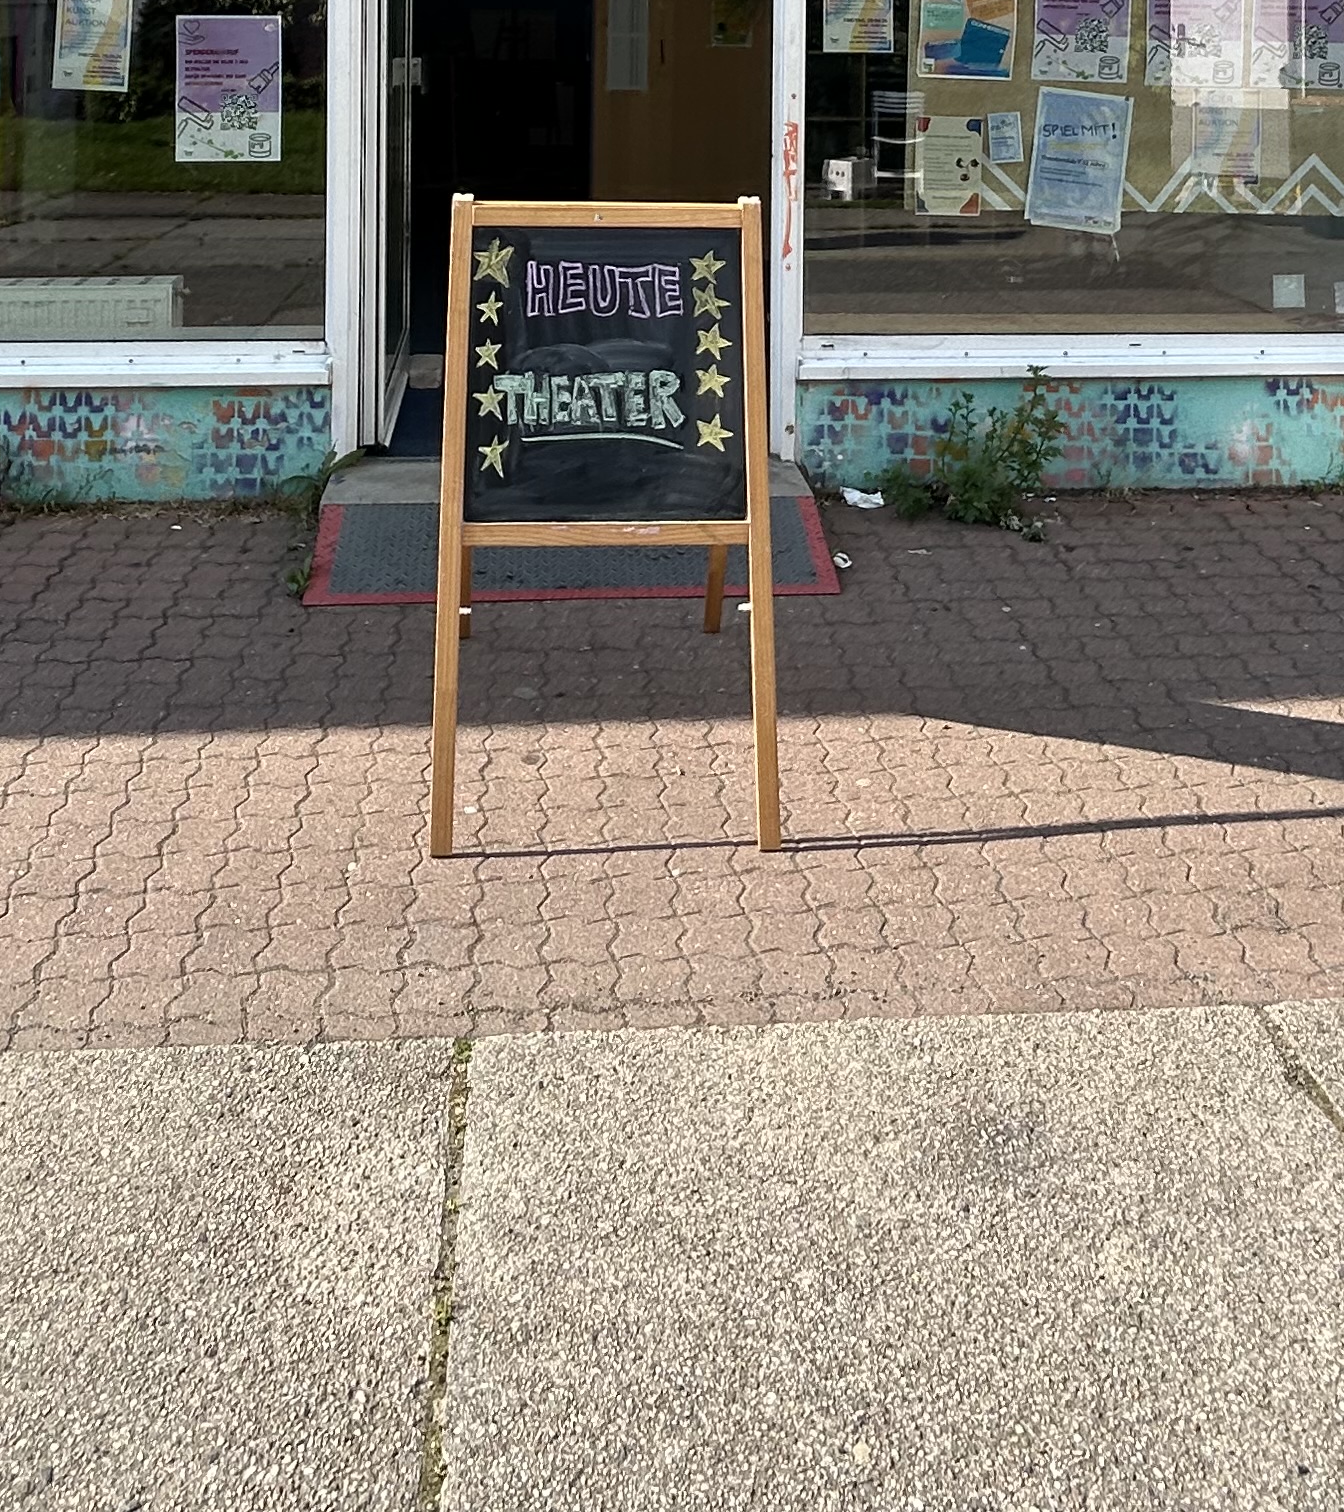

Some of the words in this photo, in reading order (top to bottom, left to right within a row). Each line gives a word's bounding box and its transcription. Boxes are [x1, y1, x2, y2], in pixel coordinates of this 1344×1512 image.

[1042, 123, 1079, 138] SPIEL
[1081, 122, 1117, 140] MIT!
[525, 260, 684, 318] HEUTE
[493, 369, 686, 430] THEATER
